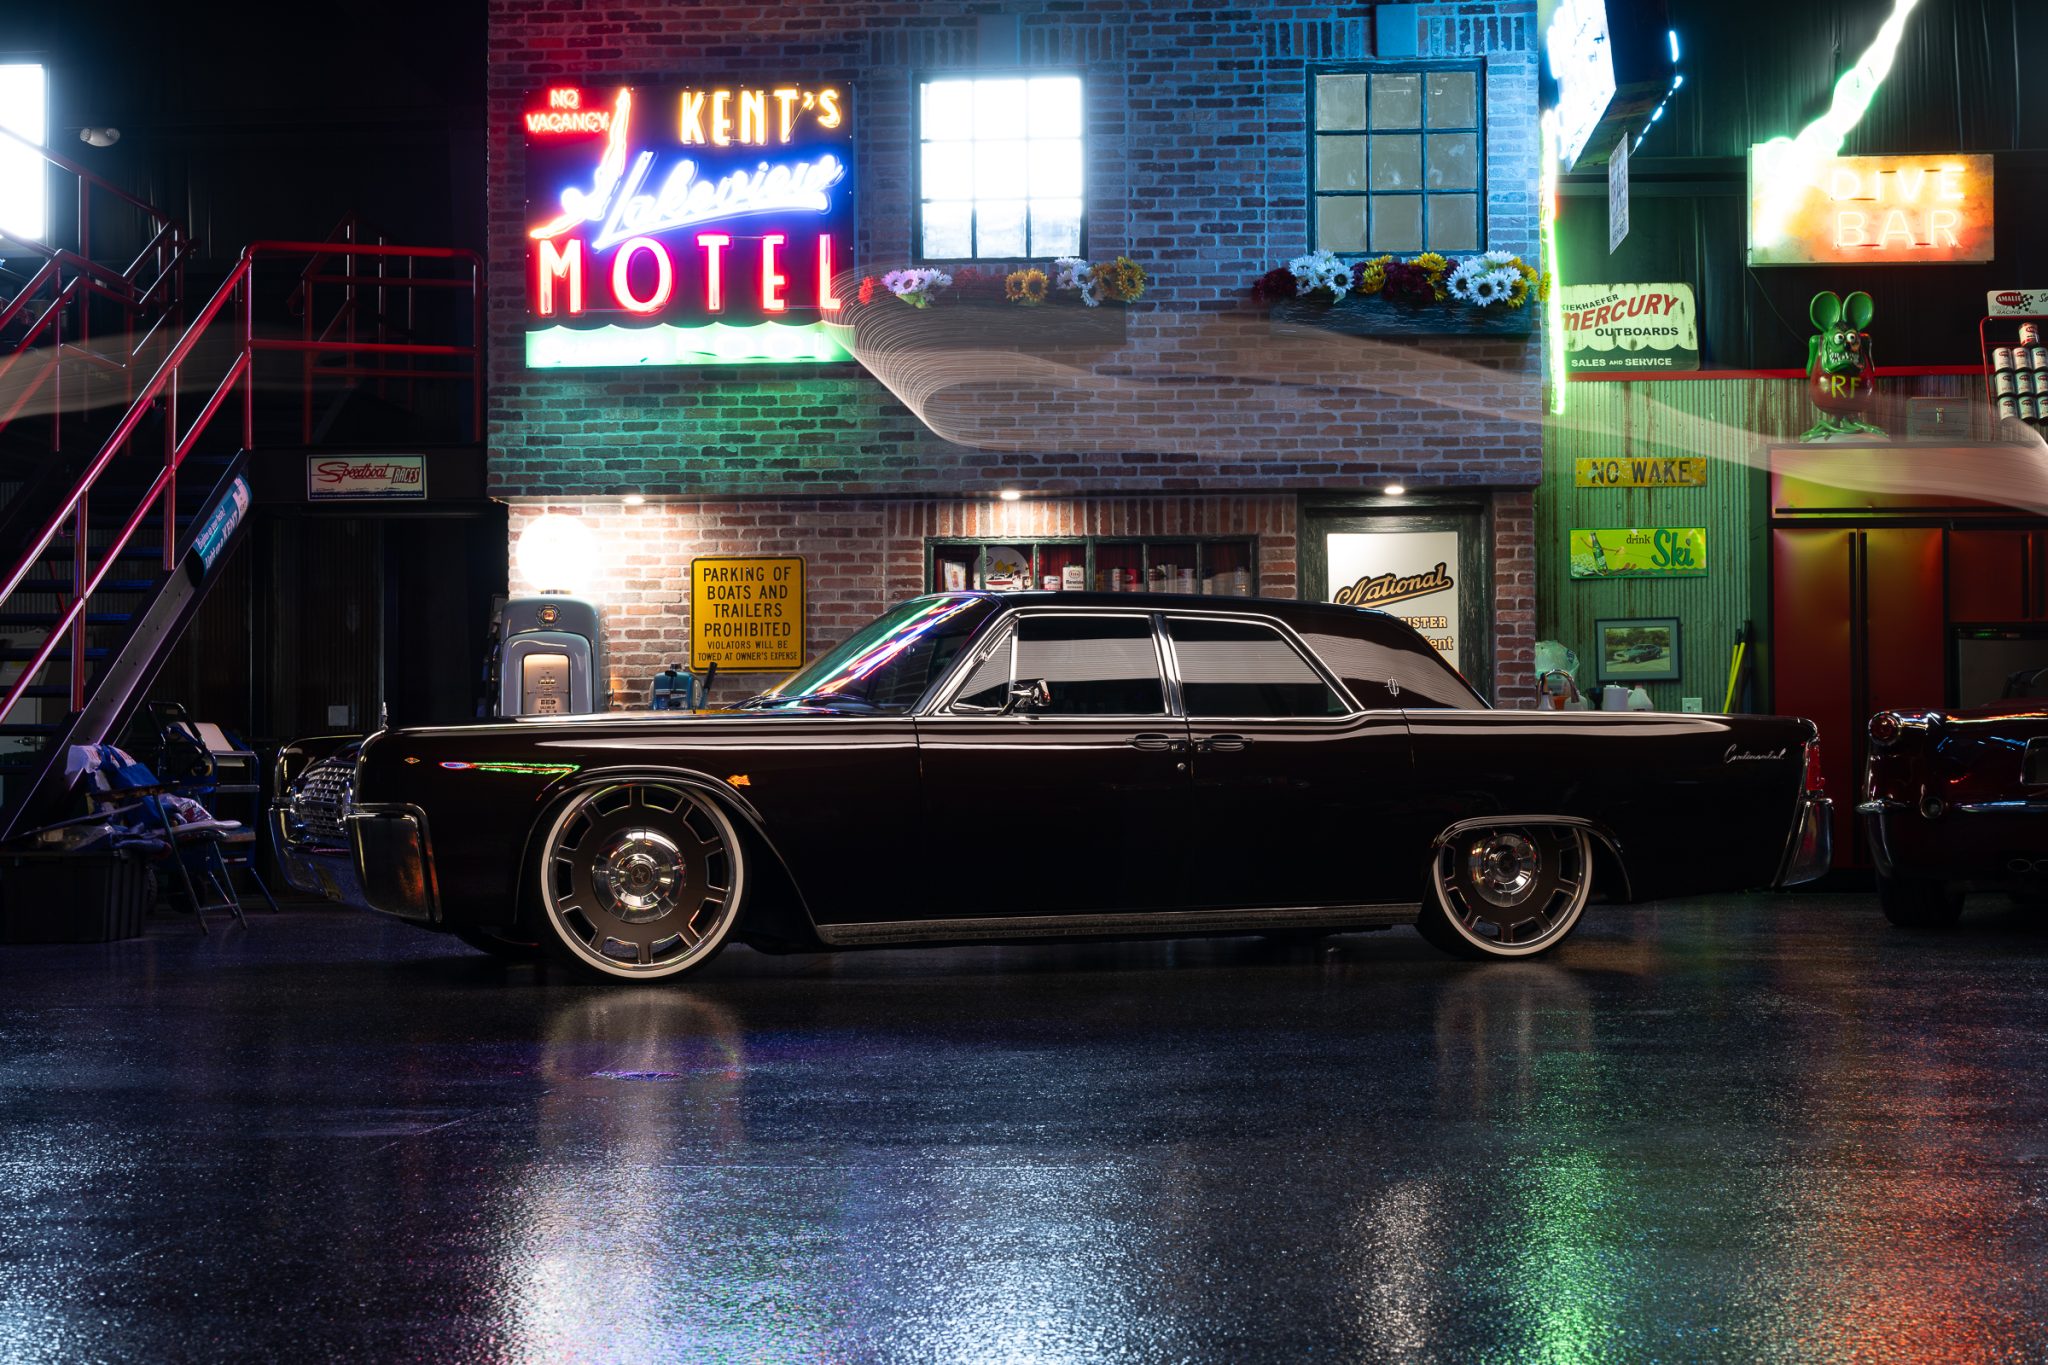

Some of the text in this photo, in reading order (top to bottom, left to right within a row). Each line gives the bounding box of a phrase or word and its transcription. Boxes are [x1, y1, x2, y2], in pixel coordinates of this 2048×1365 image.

[550, 89, 579, 109] NO
[526, 111, 610, 133] VACANCY
[681, 88, 841, 145] KENT'S
[1830, 166, 1967, 201] DIVE
[592, 150, 846, 252] Lakeview
[1834, 209, 1963, 250] BAR
[538, 233, 841, 315] MOTEL
[1595, 327, 1679, 337] OUTBOARDS
[1571, 359, 1606, 367] SALES
[1625, 358, 1672, 366] SERVICE
[1832, 375, 1862, 399] RF
[317, 462, 420, 484] Speedboat RACES
[1591, 461, 1691, 484] NO WAKE
[1626, 529, 1694, 567] drink Ski
[703, 566, 792, 582] PARKING OF
[1334, 562, 1454, 605] National
[707, 585, 788, 600] BOATS AND
[713, 603, 783, 618] TRAILERS
[704, 622, 791, 638] PROHIBITED
[707, 640, 788, 650] VIOLATORS WILL BE
[1424, 635, 1454, 650] ent
[698, 651, 798, 661] TOWED AT OWNER'S EXPENSE
